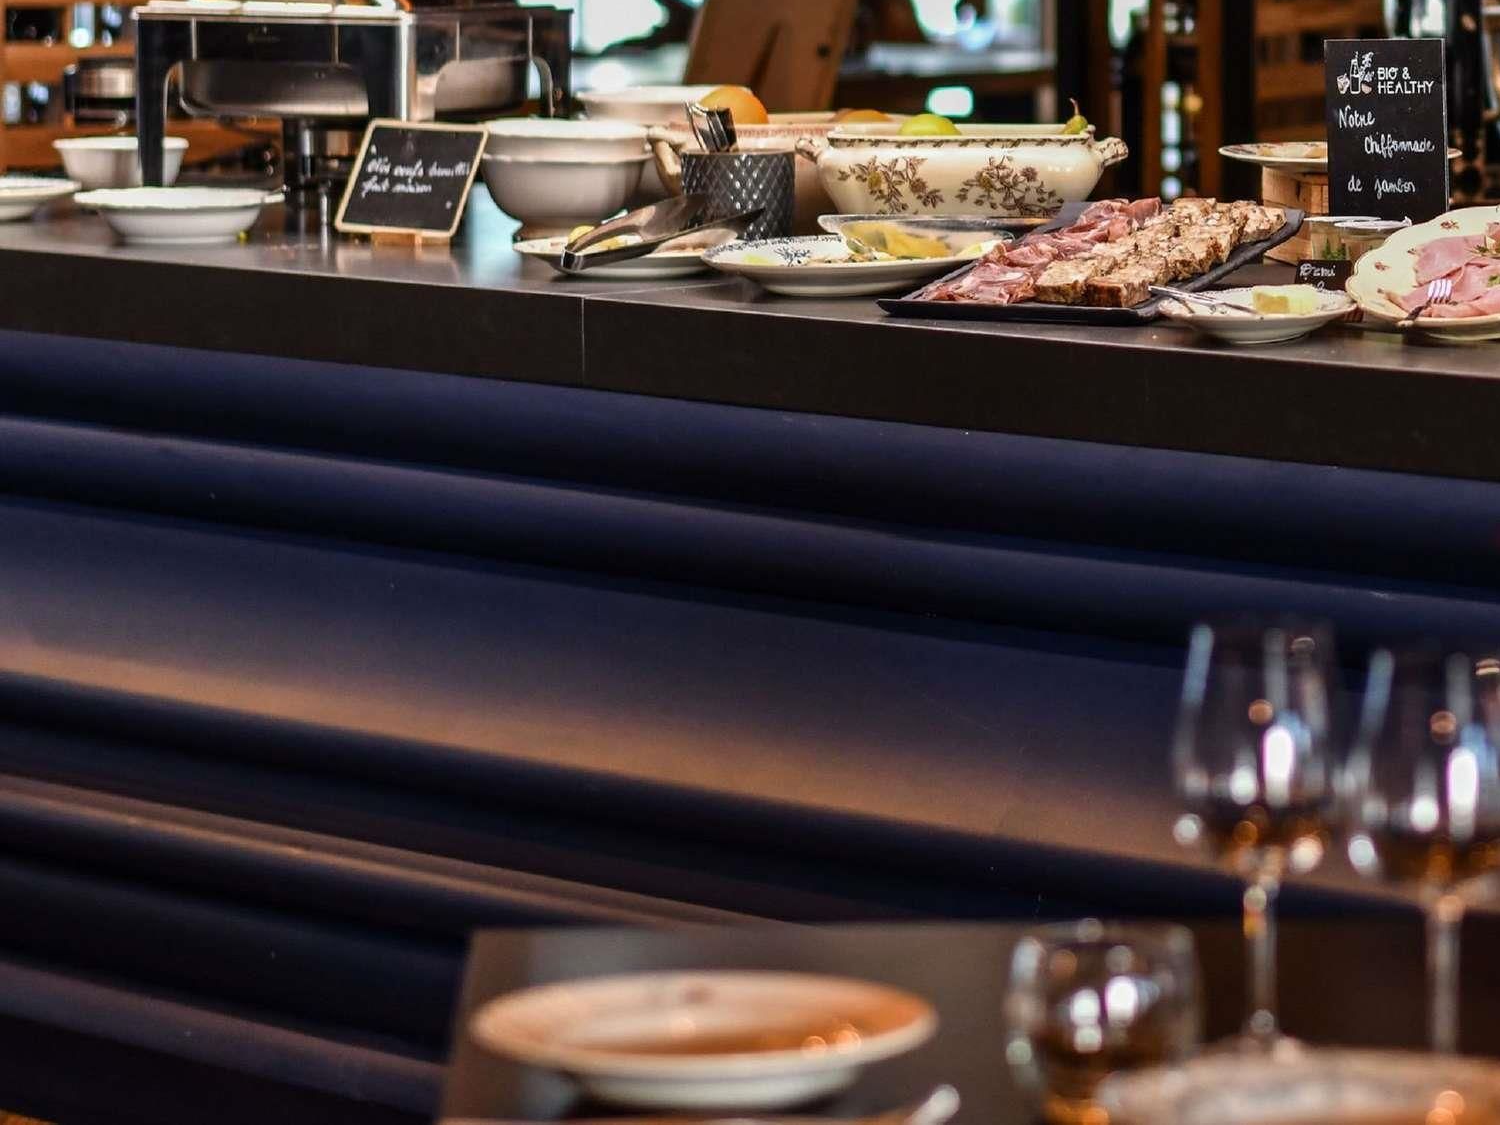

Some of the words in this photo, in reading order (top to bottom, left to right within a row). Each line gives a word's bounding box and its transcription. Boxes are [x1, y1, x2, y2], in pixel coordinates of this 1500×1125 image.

[1377, 66, 1399, 81] BIO
[1402, 66, 1411, 81] &
[1377, 80, 1435, 95] HEALTHY
[1339, 104, 1376, 129] Notre
[1347, 174, 1363, 192] de
[1374, 177, 1416, 200] jambon
